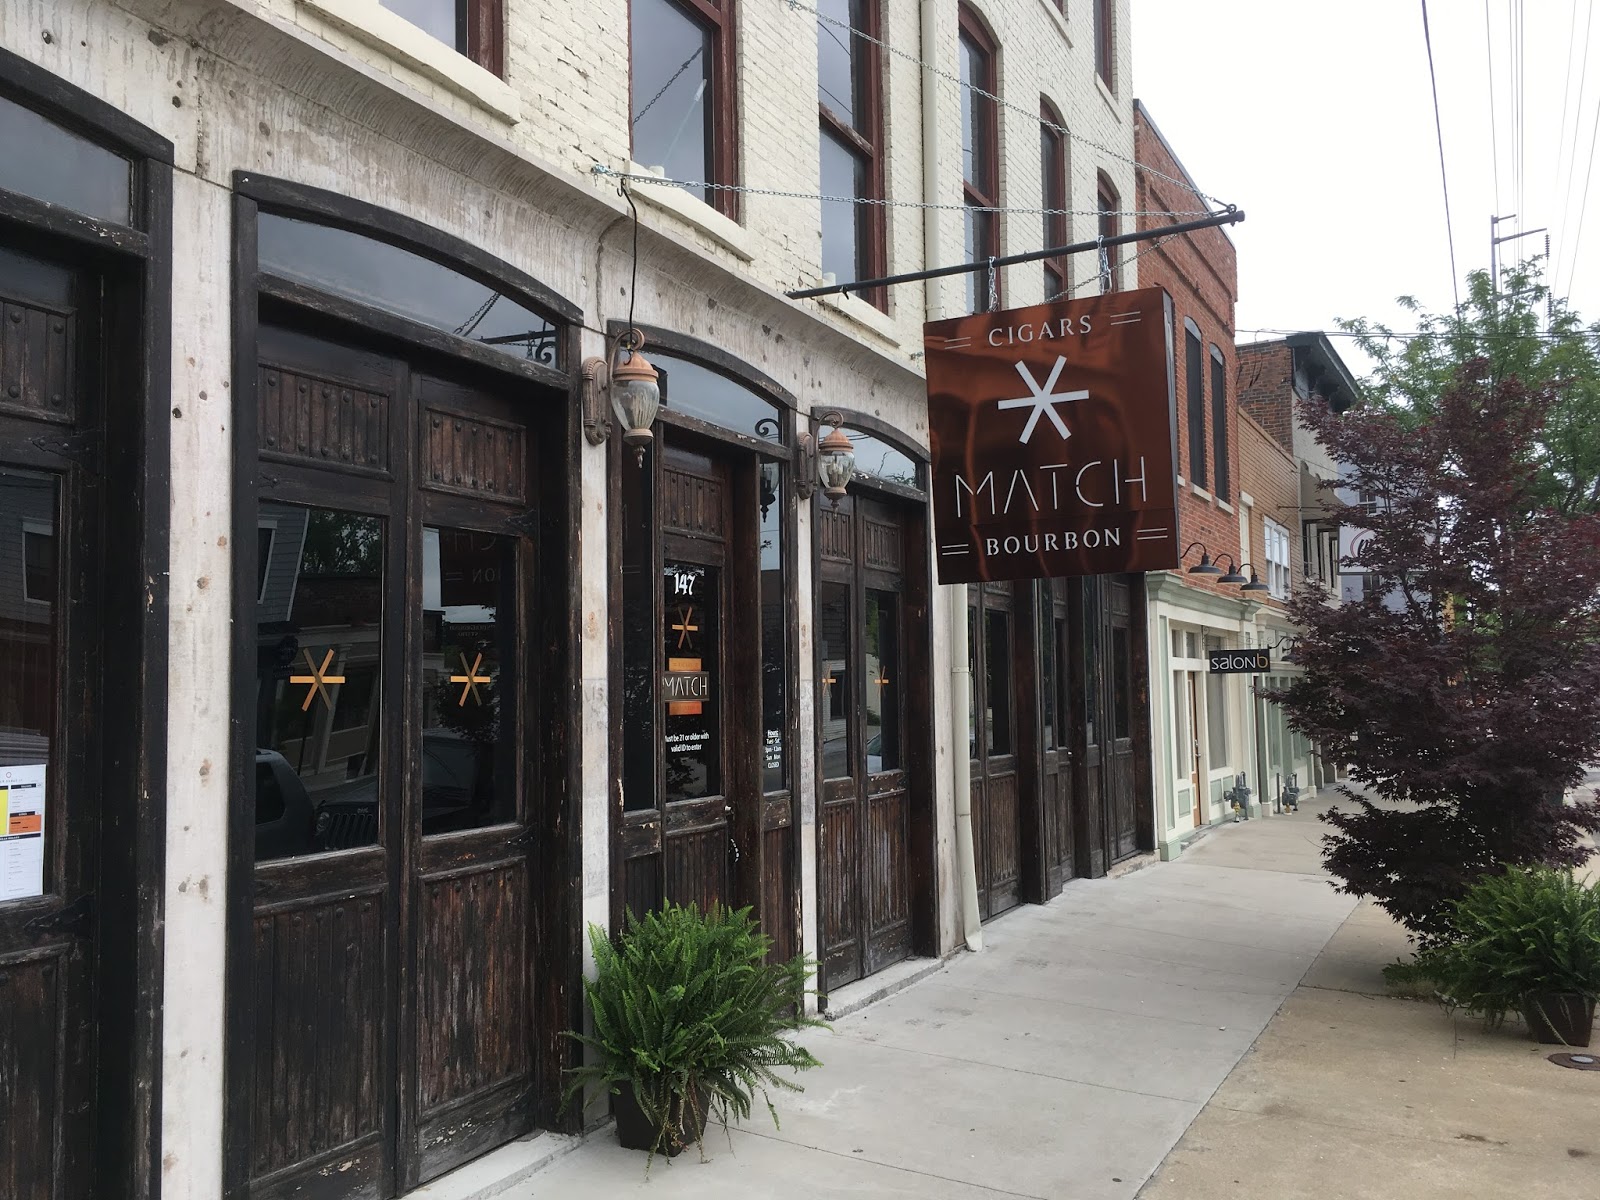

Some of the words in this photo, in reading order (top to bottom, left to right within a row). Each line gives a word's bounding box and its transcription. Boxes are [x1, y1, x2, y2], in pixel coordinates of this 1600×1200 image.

[988, 315, 1092, 347] CIGARS
[955, 456, 1147, 518] MATCH
[985, 527, 1121, 556] BOURBON
[673, 572, 696, 595] 147
[663, 676, 708, 697] MATCH
[679, 733, 685, 742] 21
